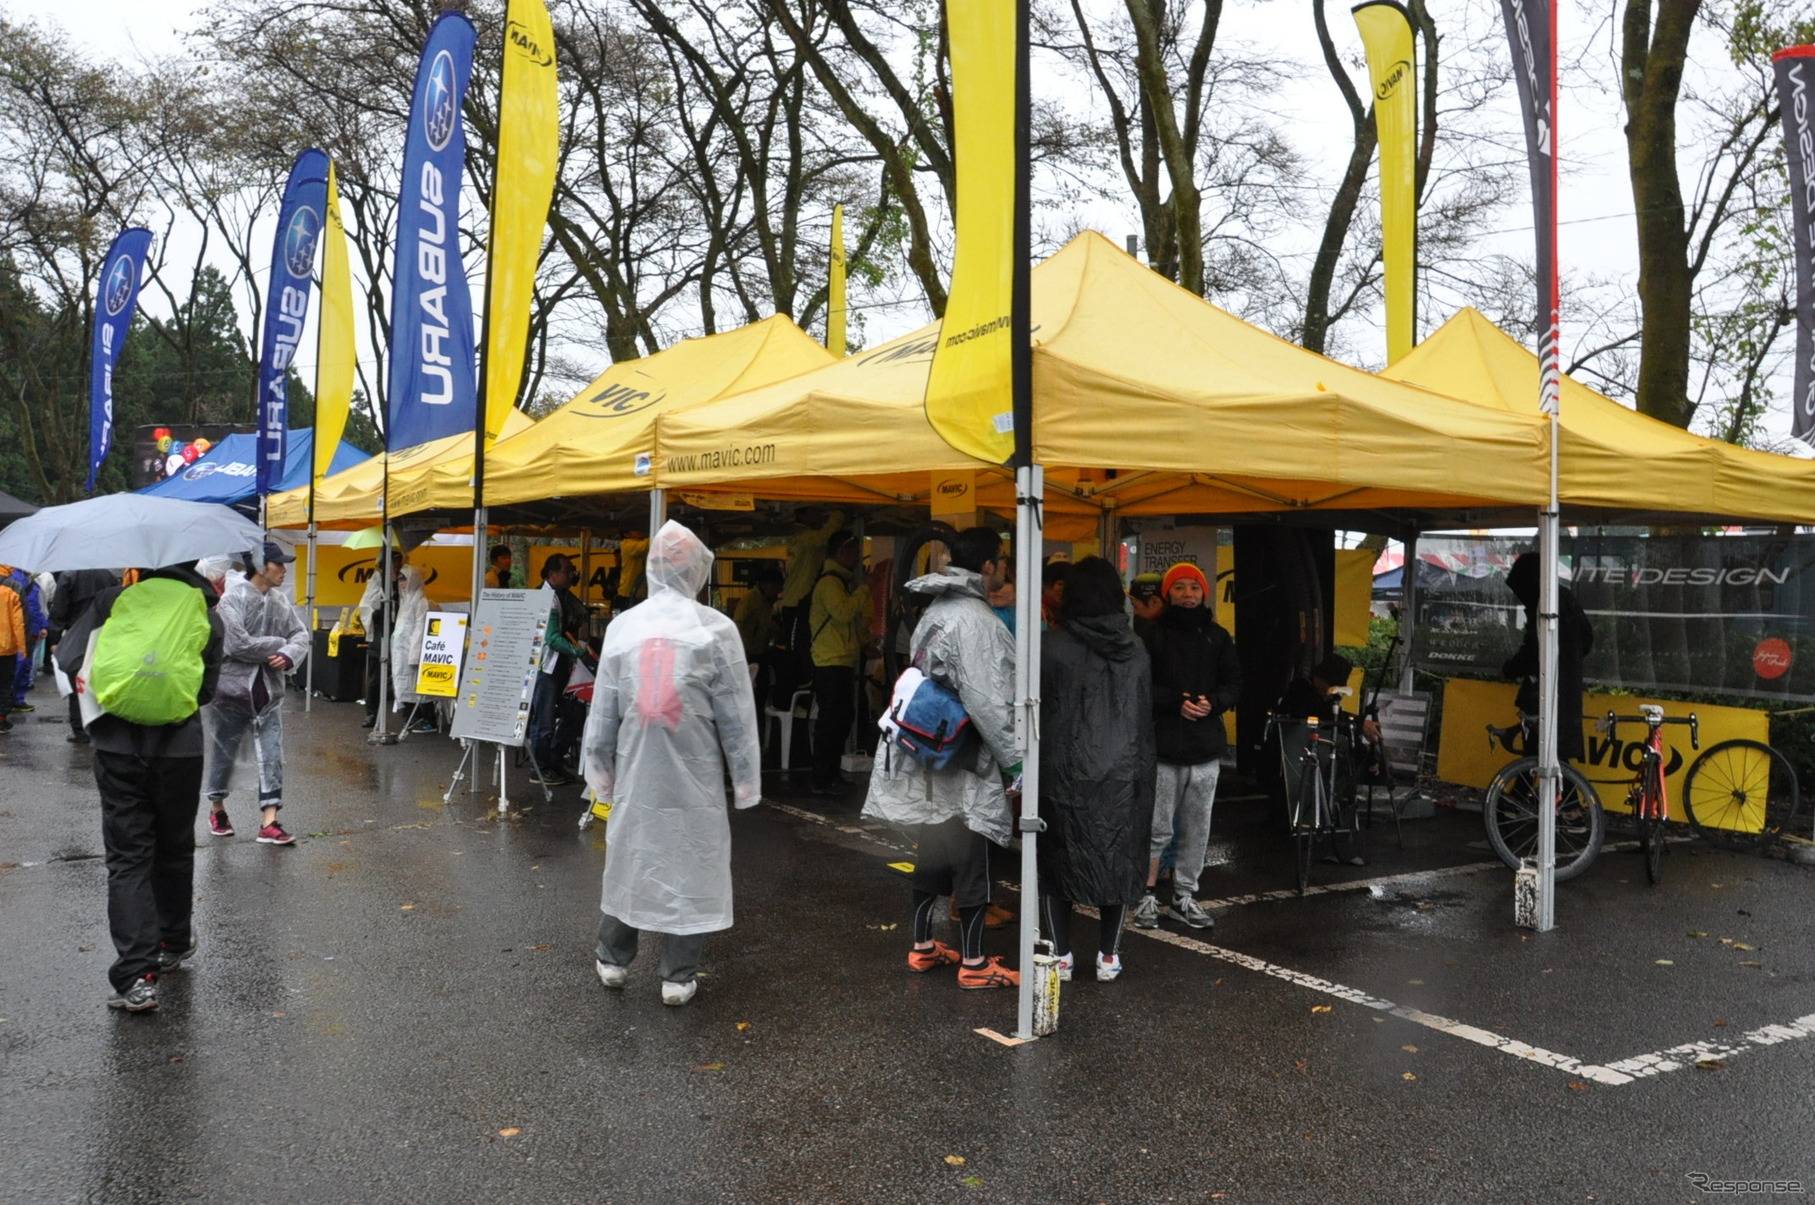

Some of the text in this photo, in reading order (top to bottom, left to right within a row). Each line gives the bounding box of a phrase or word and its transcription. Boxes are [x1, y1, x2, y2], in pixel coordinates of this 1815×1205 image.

[667, 442, 775, 474] www.mavic.com
[1144, 541, 1187, 555] ENERGY
[1636, 566, 1790, 586] DESIGN
[425, 640, 446, 652] Café
[423, 653, 453, 665] MAVIC
[426, 670, 449, 680] MAVIC
